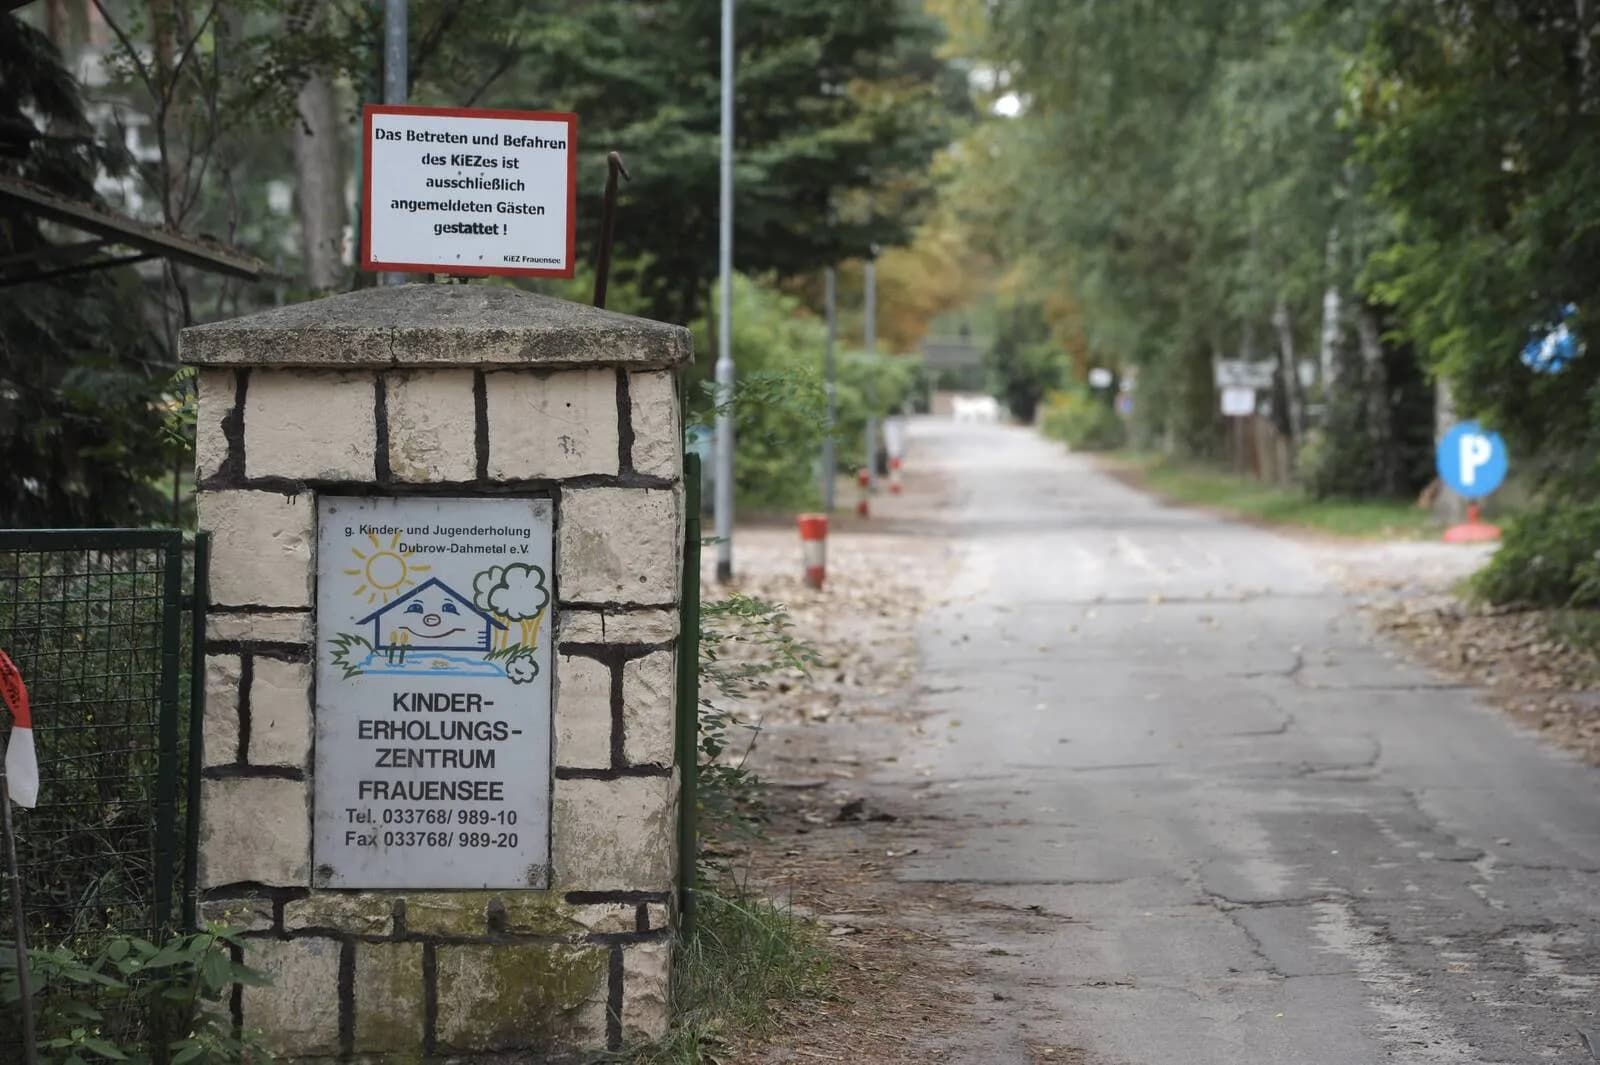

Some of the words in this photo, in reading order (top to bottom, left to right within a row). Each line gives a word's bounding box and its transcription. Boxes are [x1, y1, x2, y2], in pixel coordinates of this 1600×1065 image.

[375, 128, 401, 141] Das
[406, 130, 468, 145] Betreten
[472, 133, 498, 146] und
[503, 135, 566, 150] Befahren
[421, 153, 446, 166] des
[451, 155, 497, 168] KiEZes
[502, 156, 519, 169] ist
[426, 177, 525, 192] ausschließlich
[391, 199, 492, 214] angemeldeten
[496, 201, 545, 215] Gästen
[434, 222, 499, 236] gestattet
[502, 224, 508, 236] !
[503, 255, 520, 263] KiEZ
[522, 256, 561, 264] Frauensee
[1458, 433, 1492, 486] P
[344, 526, 355, 538] g.
[359, 525, 403, 535] Kinder-
[407, 525, 429, 535] und
[433, 525, 531, 538] Jugenderholung
[399, 543, 506, 554] Dubrow-Dahmetal
[509, 544, 529, 554] e.V.
[393, 693, 494, 713] KINDER-
[358, 720, 522, 741] ERHOLUNGS-
[375, 748, 495, 769] ZENTRUM
[358, 781, 504, 801] FRAUENSEE
[346, 809, 376, 824] Tel.
[383, 809, 452, 825] 033768/
[457, 810, 517, 825] 989-10
[345, 832, 377, 847] Fax
[384, 832, 453, 848] 033768/
[459, 833, 518, 848] 989-20
